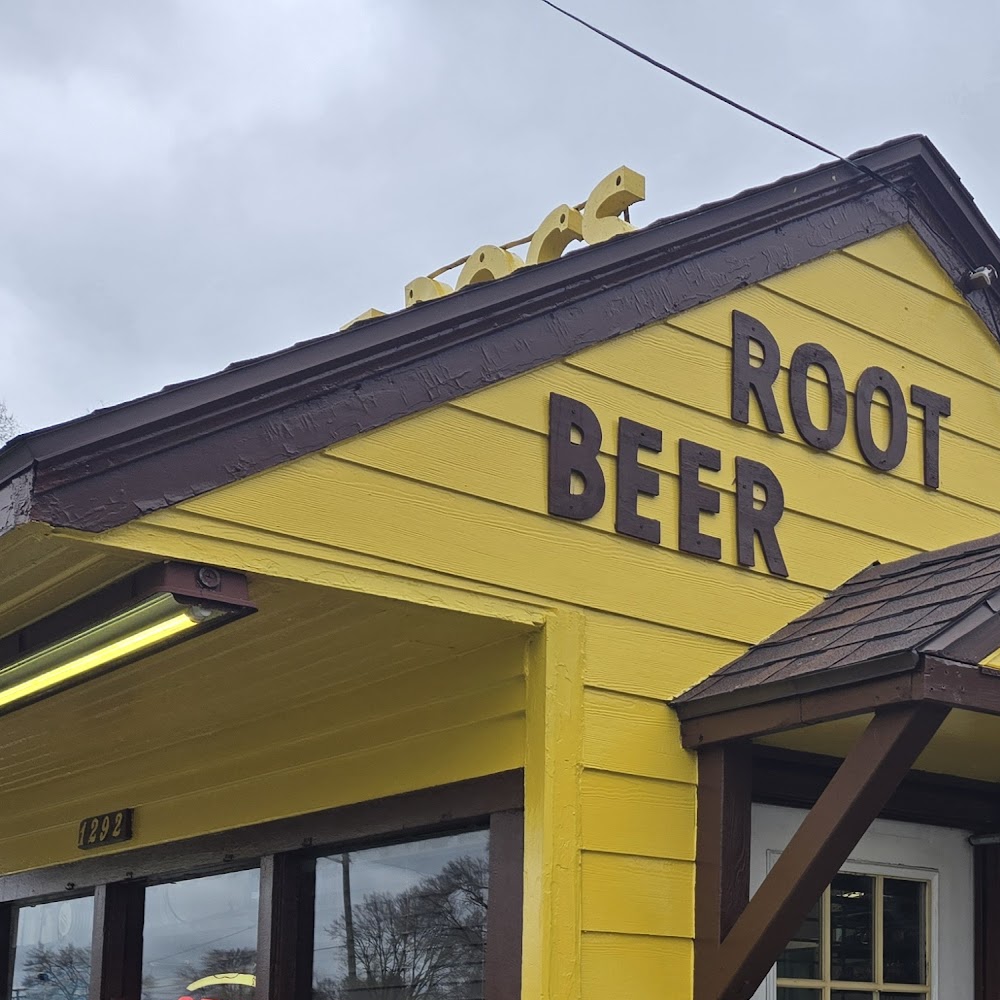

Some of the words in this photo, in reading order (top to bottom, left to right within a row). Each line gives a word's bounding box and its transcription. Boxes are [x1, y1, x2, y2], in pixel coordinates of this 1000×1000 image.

[547, 391, 789, 578] BEER
[730, 309, 952, 489] ROOT
[78, 812, 123, 846] 1292
